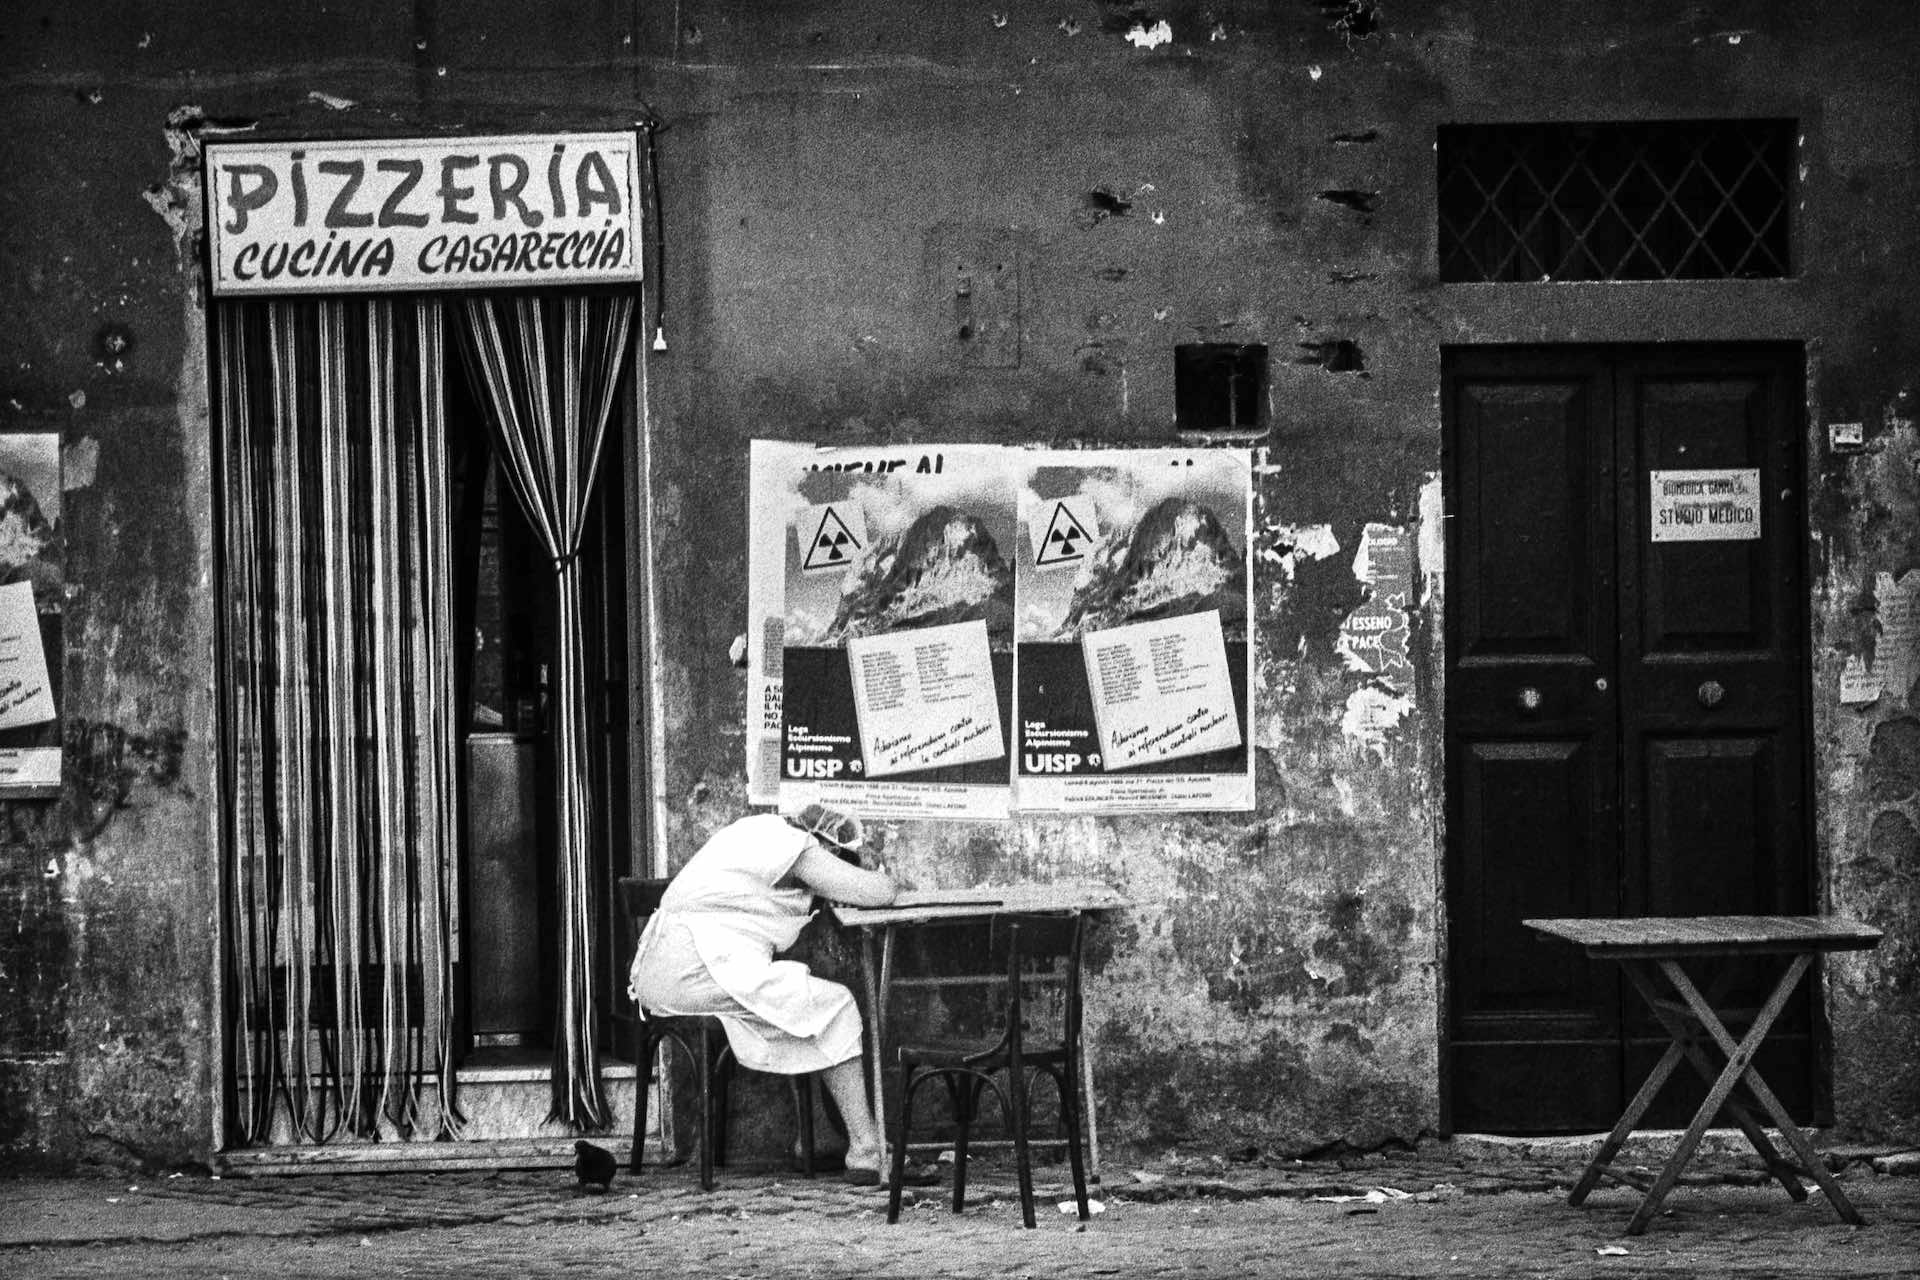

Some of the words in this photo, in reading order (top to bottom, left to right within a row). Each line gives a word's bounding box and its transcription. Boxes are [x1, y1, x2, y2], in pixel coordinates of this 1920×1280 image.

[223, 144, 622, 235] PIZZERIA
[233, 231, 394, 281] CUCINA
[418, 219, 625, 275] CASARECCIA
[1659, 508, 1703, 526] STUDIO
[1708, 506, 1753, 525] MEDICO
[764, 711, 778, 720] NO
[1025, 720, 1046, 731] Lega
[788, 724, 808, 736] Lega
[788, 733, 852, 743] Escursionismo
[900, 731, 946, 761] referendum
[950, 716, 973, 733] contro
[1025, 729, 1089, 738] Escursionismo
[1138, 723, 1183, 754] referendum
[1186, 707, 1209, 724] contro
[1170, 727, 1198, 750] centrali
[788, 743, 833, 753] Alpinismo
[932, 737, 961, 759] centrali
[1025, 738, 1071, 749] Alpinismo
[787, 758, 843, 778] UISP
[1025, 753, 1082, 773] UISP
